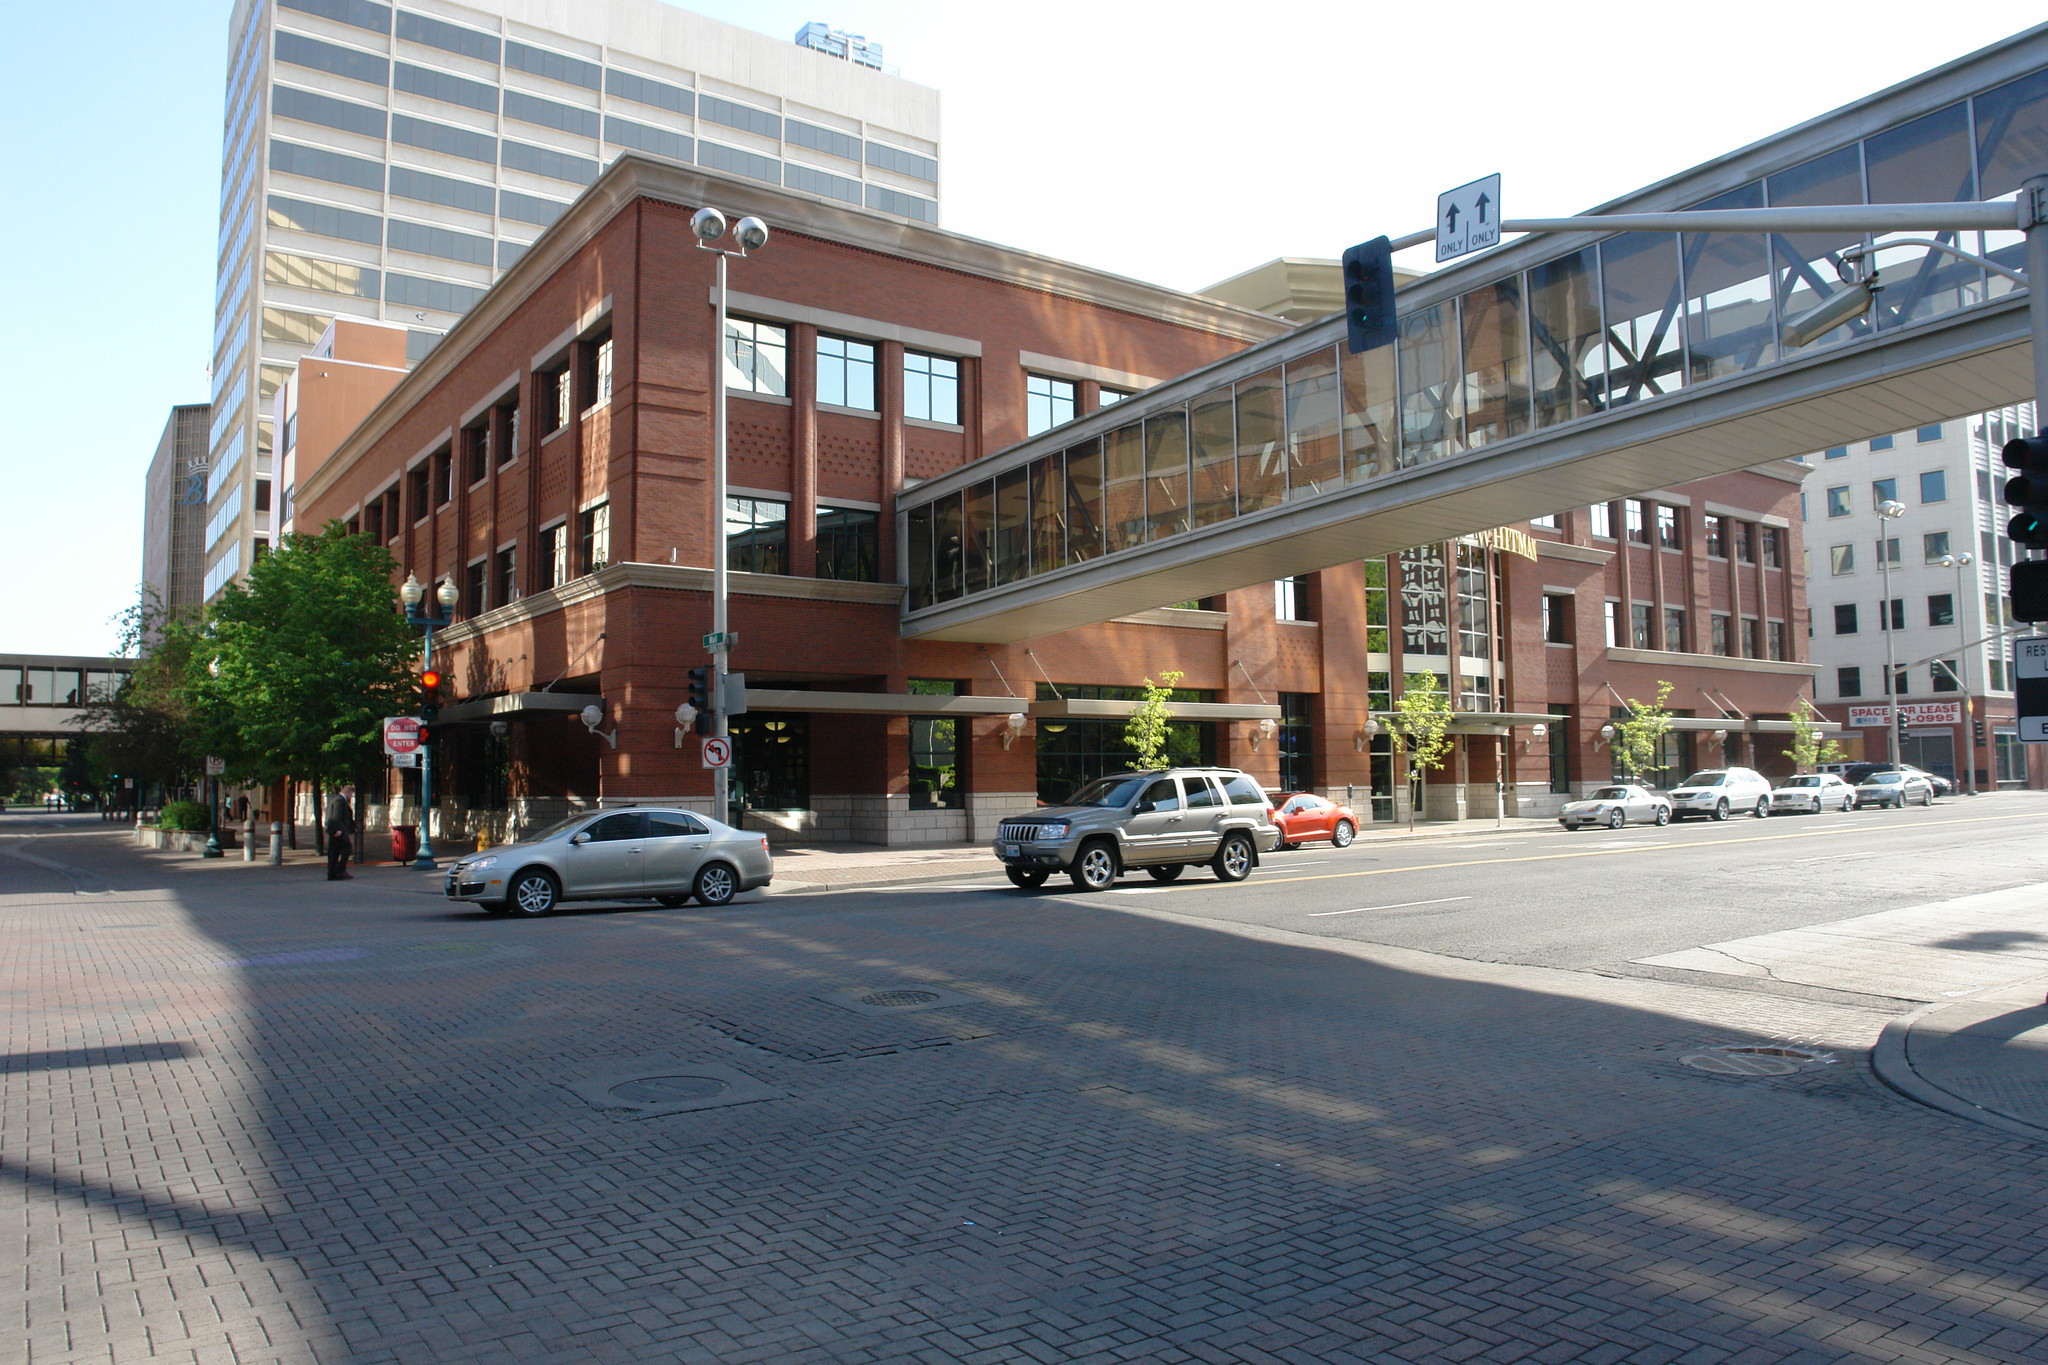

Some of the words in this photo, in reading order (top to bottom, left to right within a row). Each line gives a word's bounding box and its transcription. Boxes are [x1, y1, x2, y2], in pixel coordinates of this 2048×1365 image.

[1472, 228, 1496, 246] ONLY
[1441, 239, 1463, 256] ONLY
[1851, 707, 1889, 717] SPACE
[1919, 704, 1959, 714] LEASE
